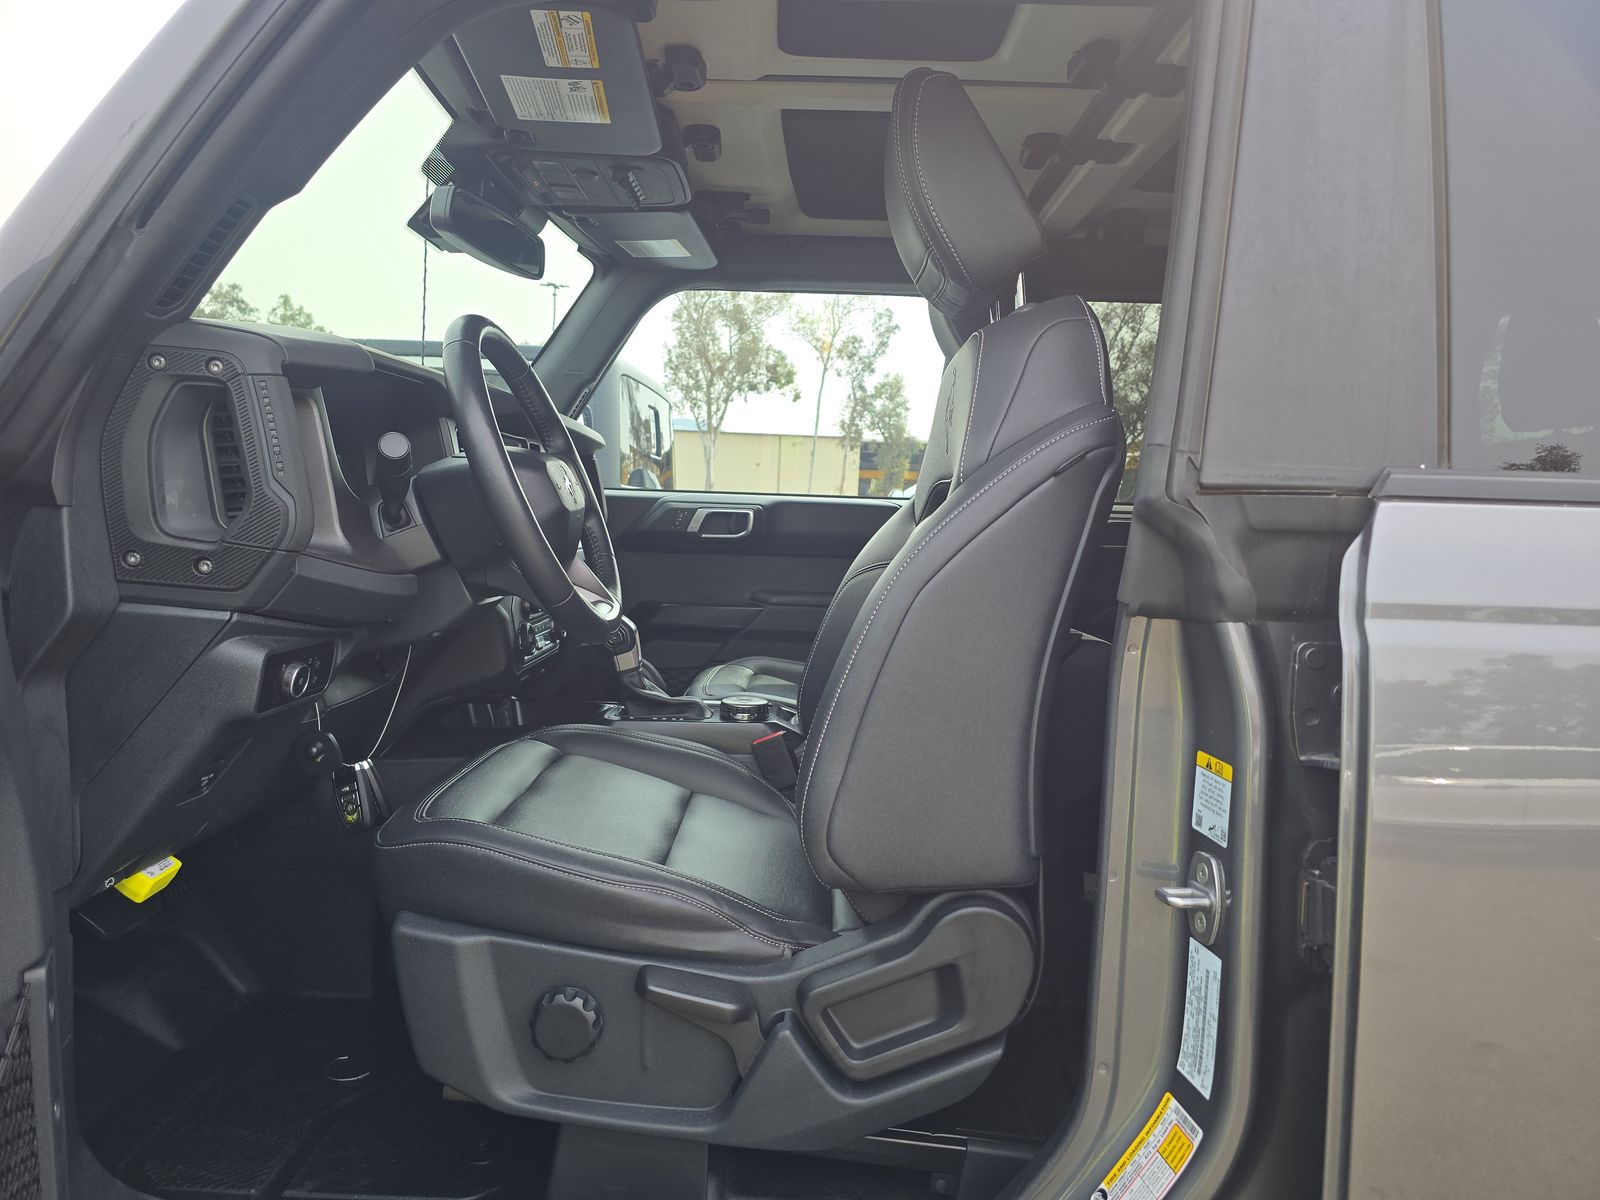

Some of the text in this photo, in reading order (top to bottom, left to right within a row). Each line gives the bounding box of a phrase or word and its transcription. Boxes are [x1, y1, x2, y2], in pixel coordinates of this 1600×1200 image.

[259, 380, 284, 476] BRONCO
[1107, 1173, 1117, 1186] TIRE
[1116, 1160, 1127, 1173] AND
[1126, 1136, 1145, 1160] LOADING
[1144, 1097, 1170, 1136] INFORMATION
